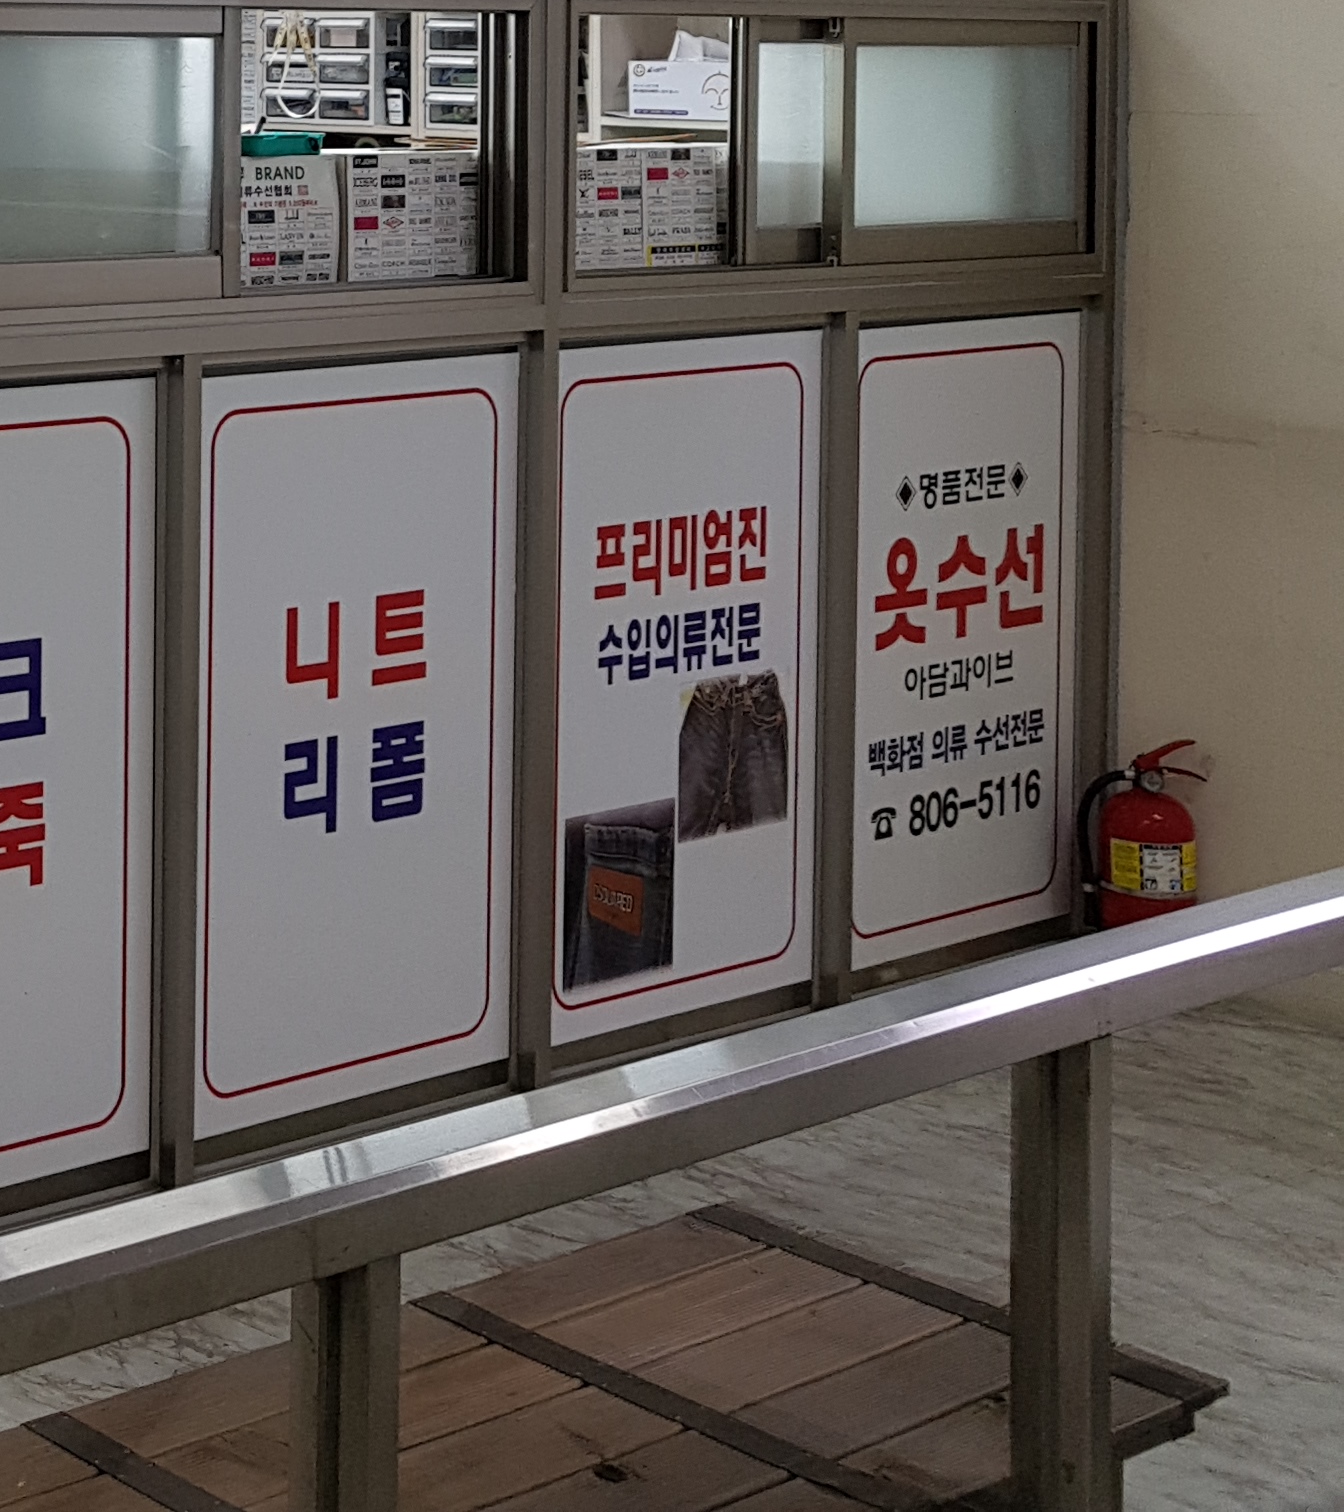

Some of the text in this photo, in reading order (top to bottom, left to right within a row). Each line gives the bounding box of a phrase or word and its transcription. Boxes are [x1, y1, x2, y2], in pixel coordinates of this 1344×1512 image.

[255, 166, 305, 181] BRAND
[919, 464, 1006, 509] 명품전문
[594, 506, 767, 600] 프리미엄진
[875, 523, 1044, 651] 옷수선
[286, 589, 428, 700] 니트
[598, 602, 761, 685] 수입의류전문
[904, 650, 1014, 700] 아담과이브
[284, 720, 426, 834] 리폼
[868, 708, 1045, 777] 백화점 의류 수선전문
[909, 769, 1041, 836] 806-5116
